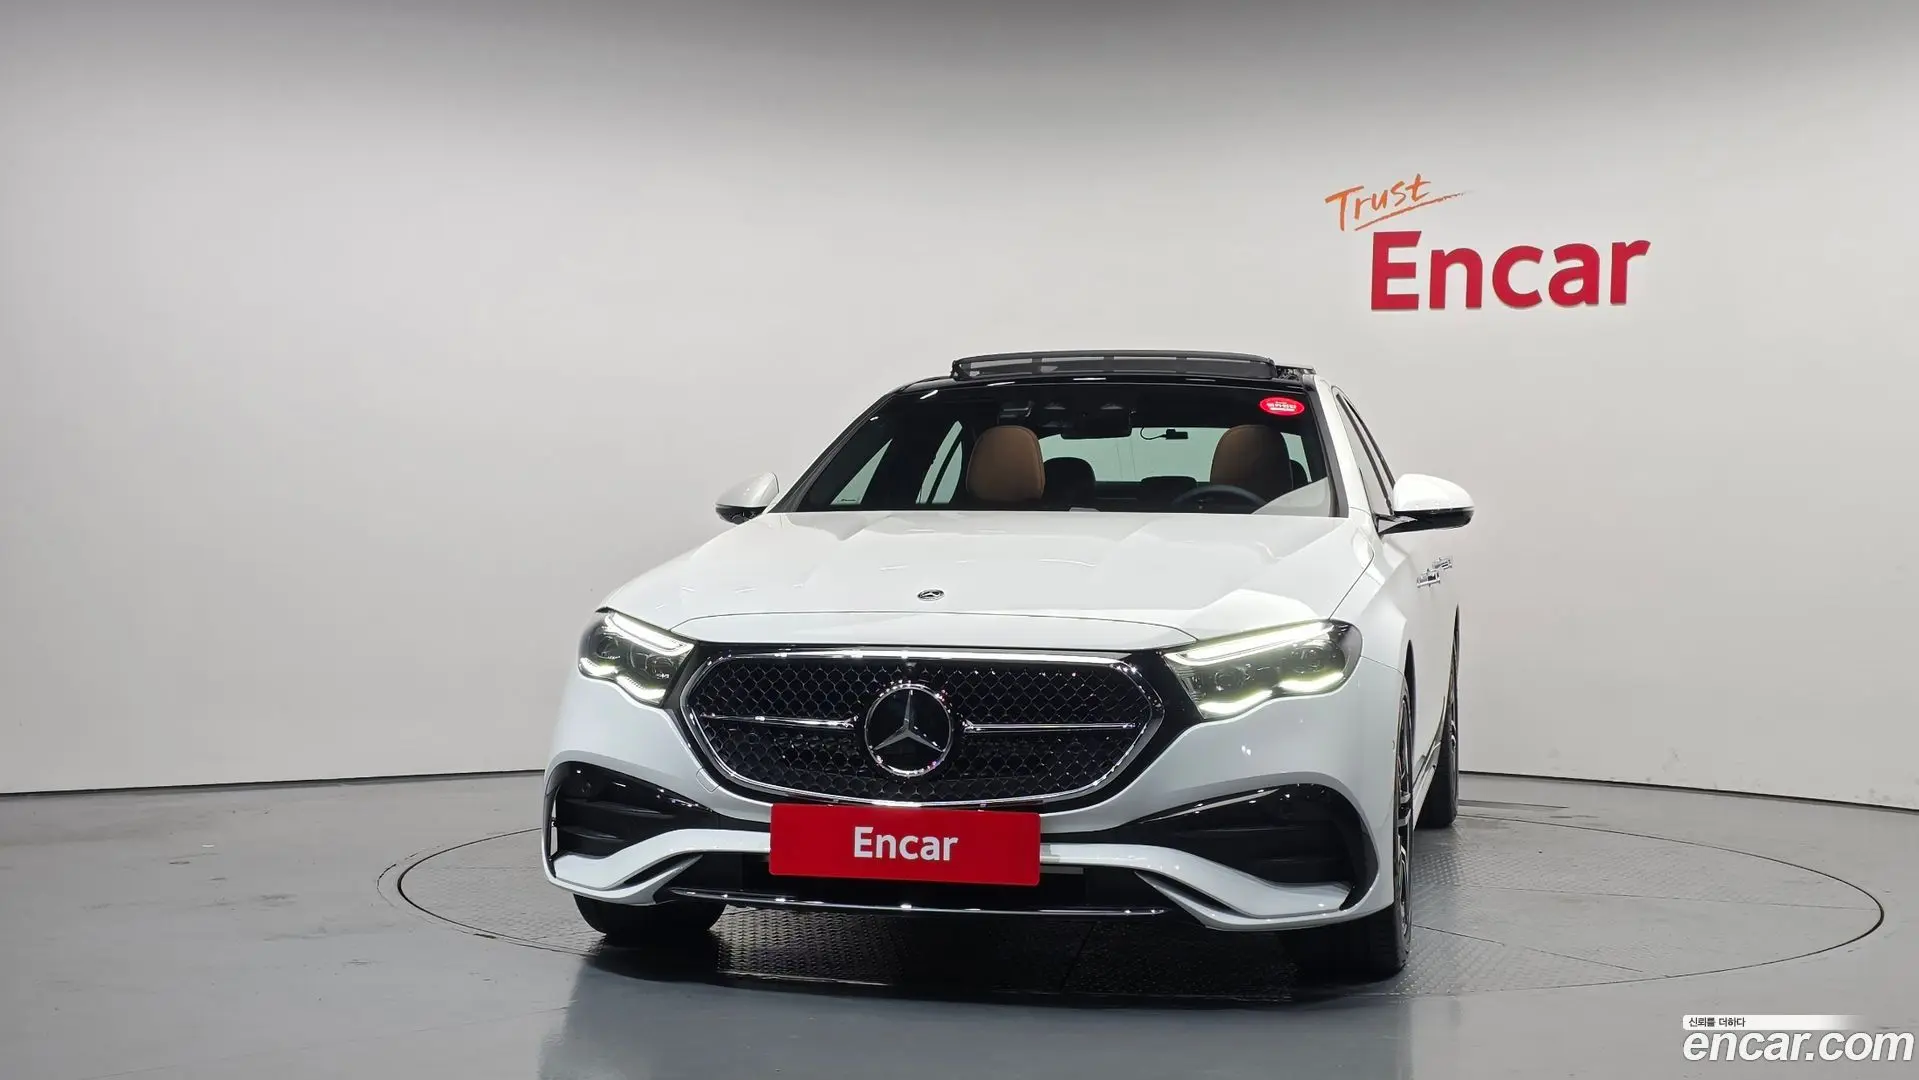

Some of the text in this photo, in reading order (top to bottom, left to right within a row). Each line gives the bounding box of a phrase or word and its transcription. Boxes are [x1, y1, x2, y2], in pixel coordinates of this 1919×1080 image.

[1325, 173, 1431, 231] Trust
[1370, 230, 1651, 311] Encar
[853, 826, 959, 861] Encar
